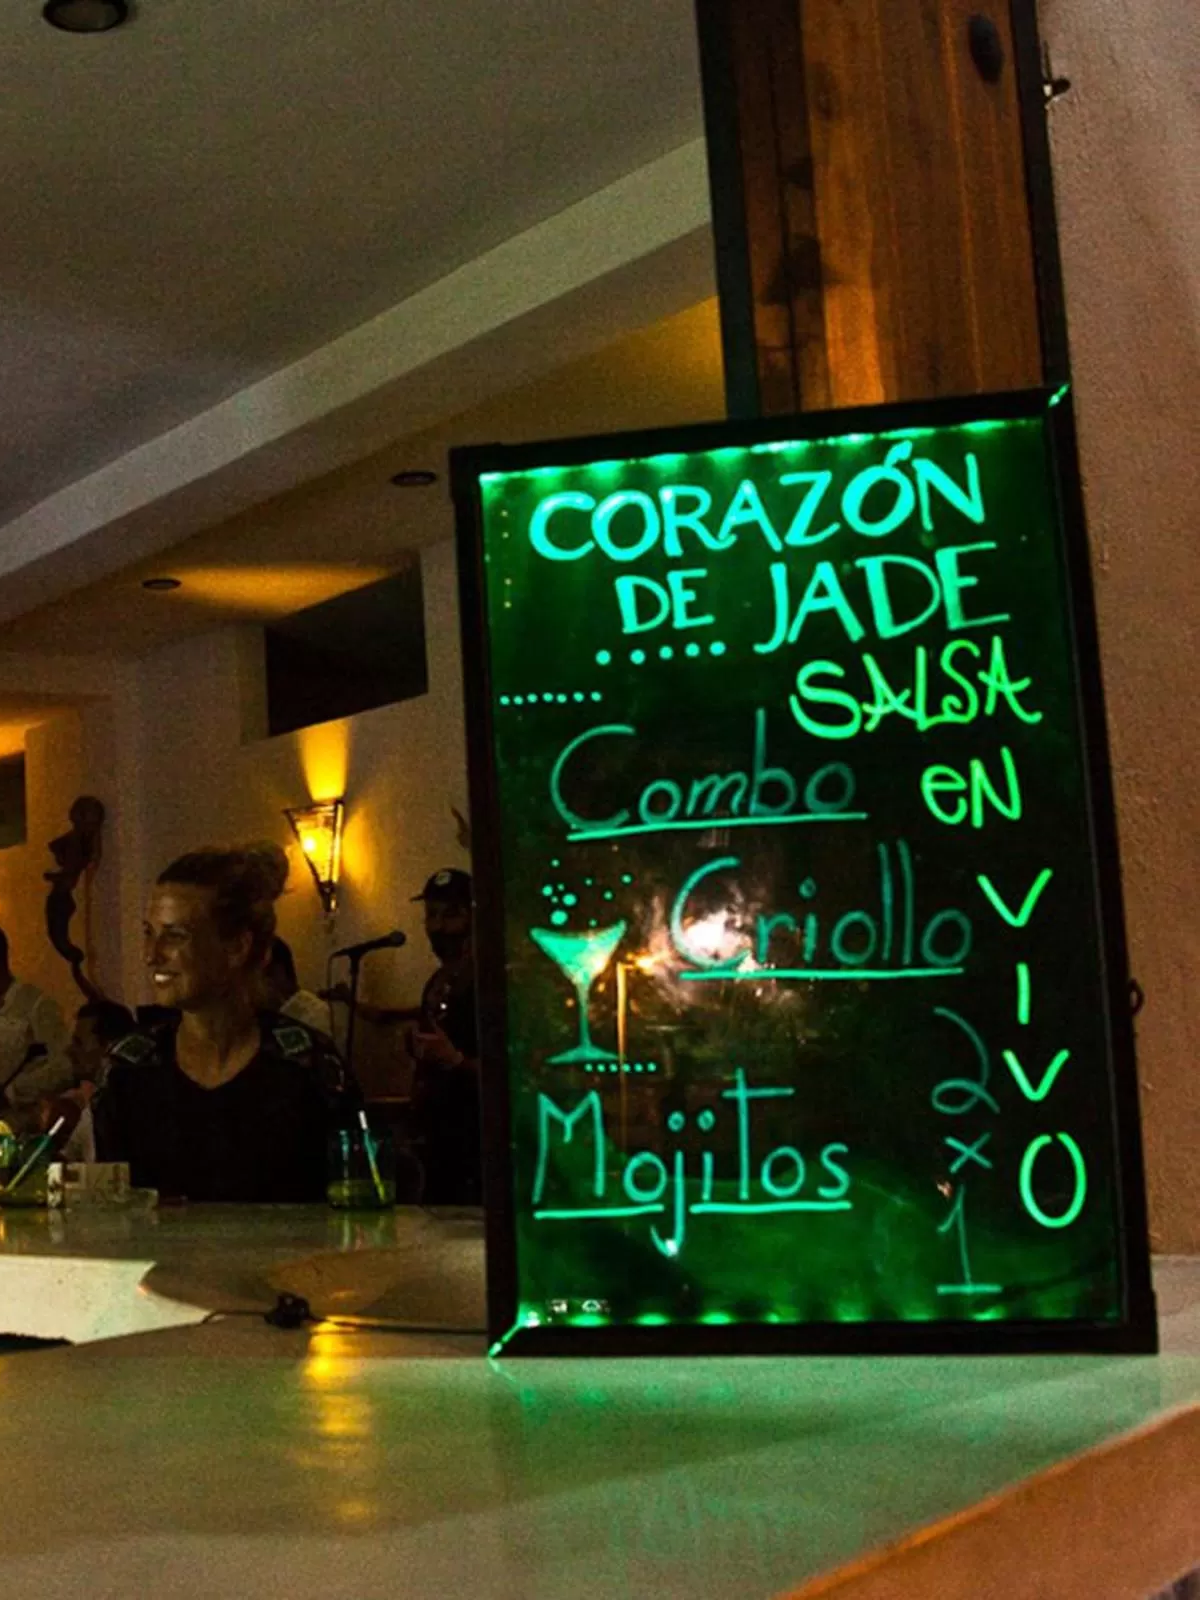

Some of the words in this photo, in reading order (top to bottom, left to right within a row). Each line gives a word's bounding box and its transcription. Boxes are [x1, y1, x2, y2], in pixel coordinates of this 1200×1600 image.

[529, 440, 986, 561] CORAZÓN
[614, 567, 715, 634] DE
[753, 541, 1011, 654] JADE
[789, 635, 1043, 740] SALSA
[549, 707, 857, 829] Combo
[670, 839, 973, 967] Criollo
[532, 1067, 852, 1257] Mojitos
